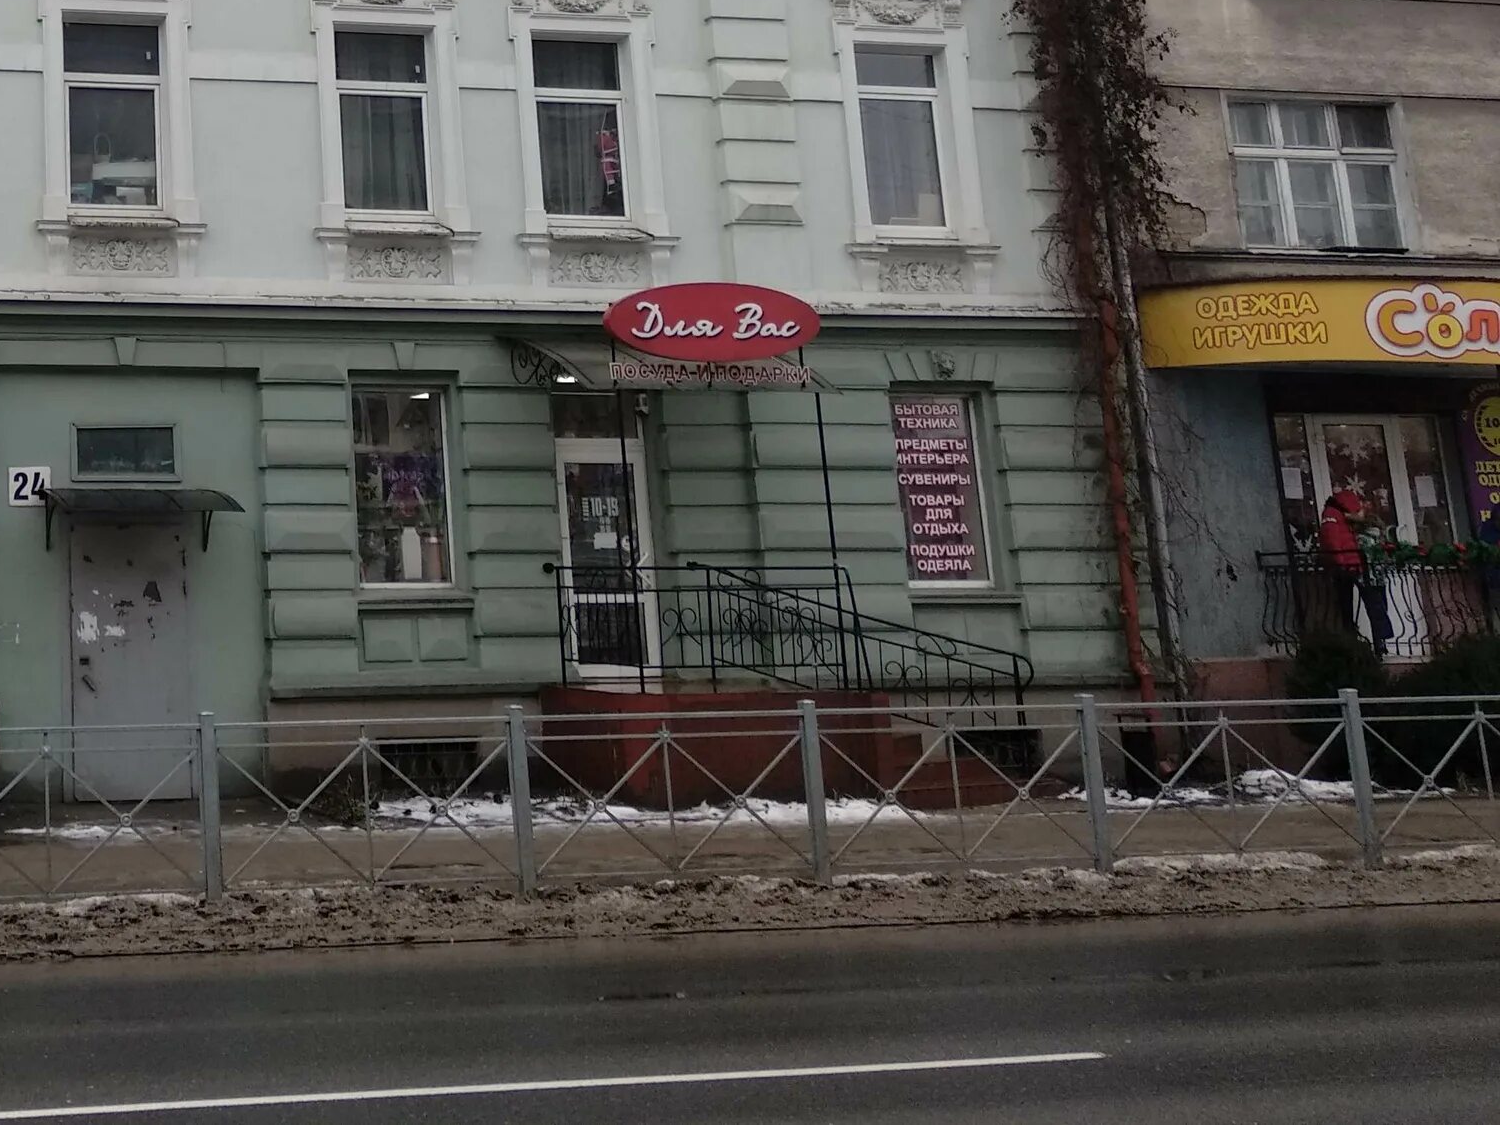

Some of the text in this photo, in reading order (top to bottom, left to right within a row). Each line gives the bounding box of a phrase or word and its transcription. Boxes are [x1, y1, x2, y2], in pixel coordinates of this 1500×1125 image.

[1196, 292, 1318, 321] ОДЕЖДА
[632, 301, 801, 340] Для Вас
[1193, 322, 1328, 349] ИГРУШКИ
[609, 362, 691, 383] ПОСУДА
[715, 363, 811, 383] ПОДАРКИ
[895, 404, 959, 416] БЫТОВАЯ
[898, 418, 957, 429] ТЕХНИКА
[895, 439, 967, 451] ПРЕДМЕТЫ
[899, 474, 971, 485] СУВЕНИРЫ
[14, 472, 45, 500] 24
[909, 495, 965, 506] ТОВАРЫ
[926, 509, 953, 521] ДЛЯ
[913, 523, 969, 535] ОТДЫХА
[911, 545, 975, 557] ПОДУШКИ
[918, 560, 972, 573] ОДЕЯЛА
